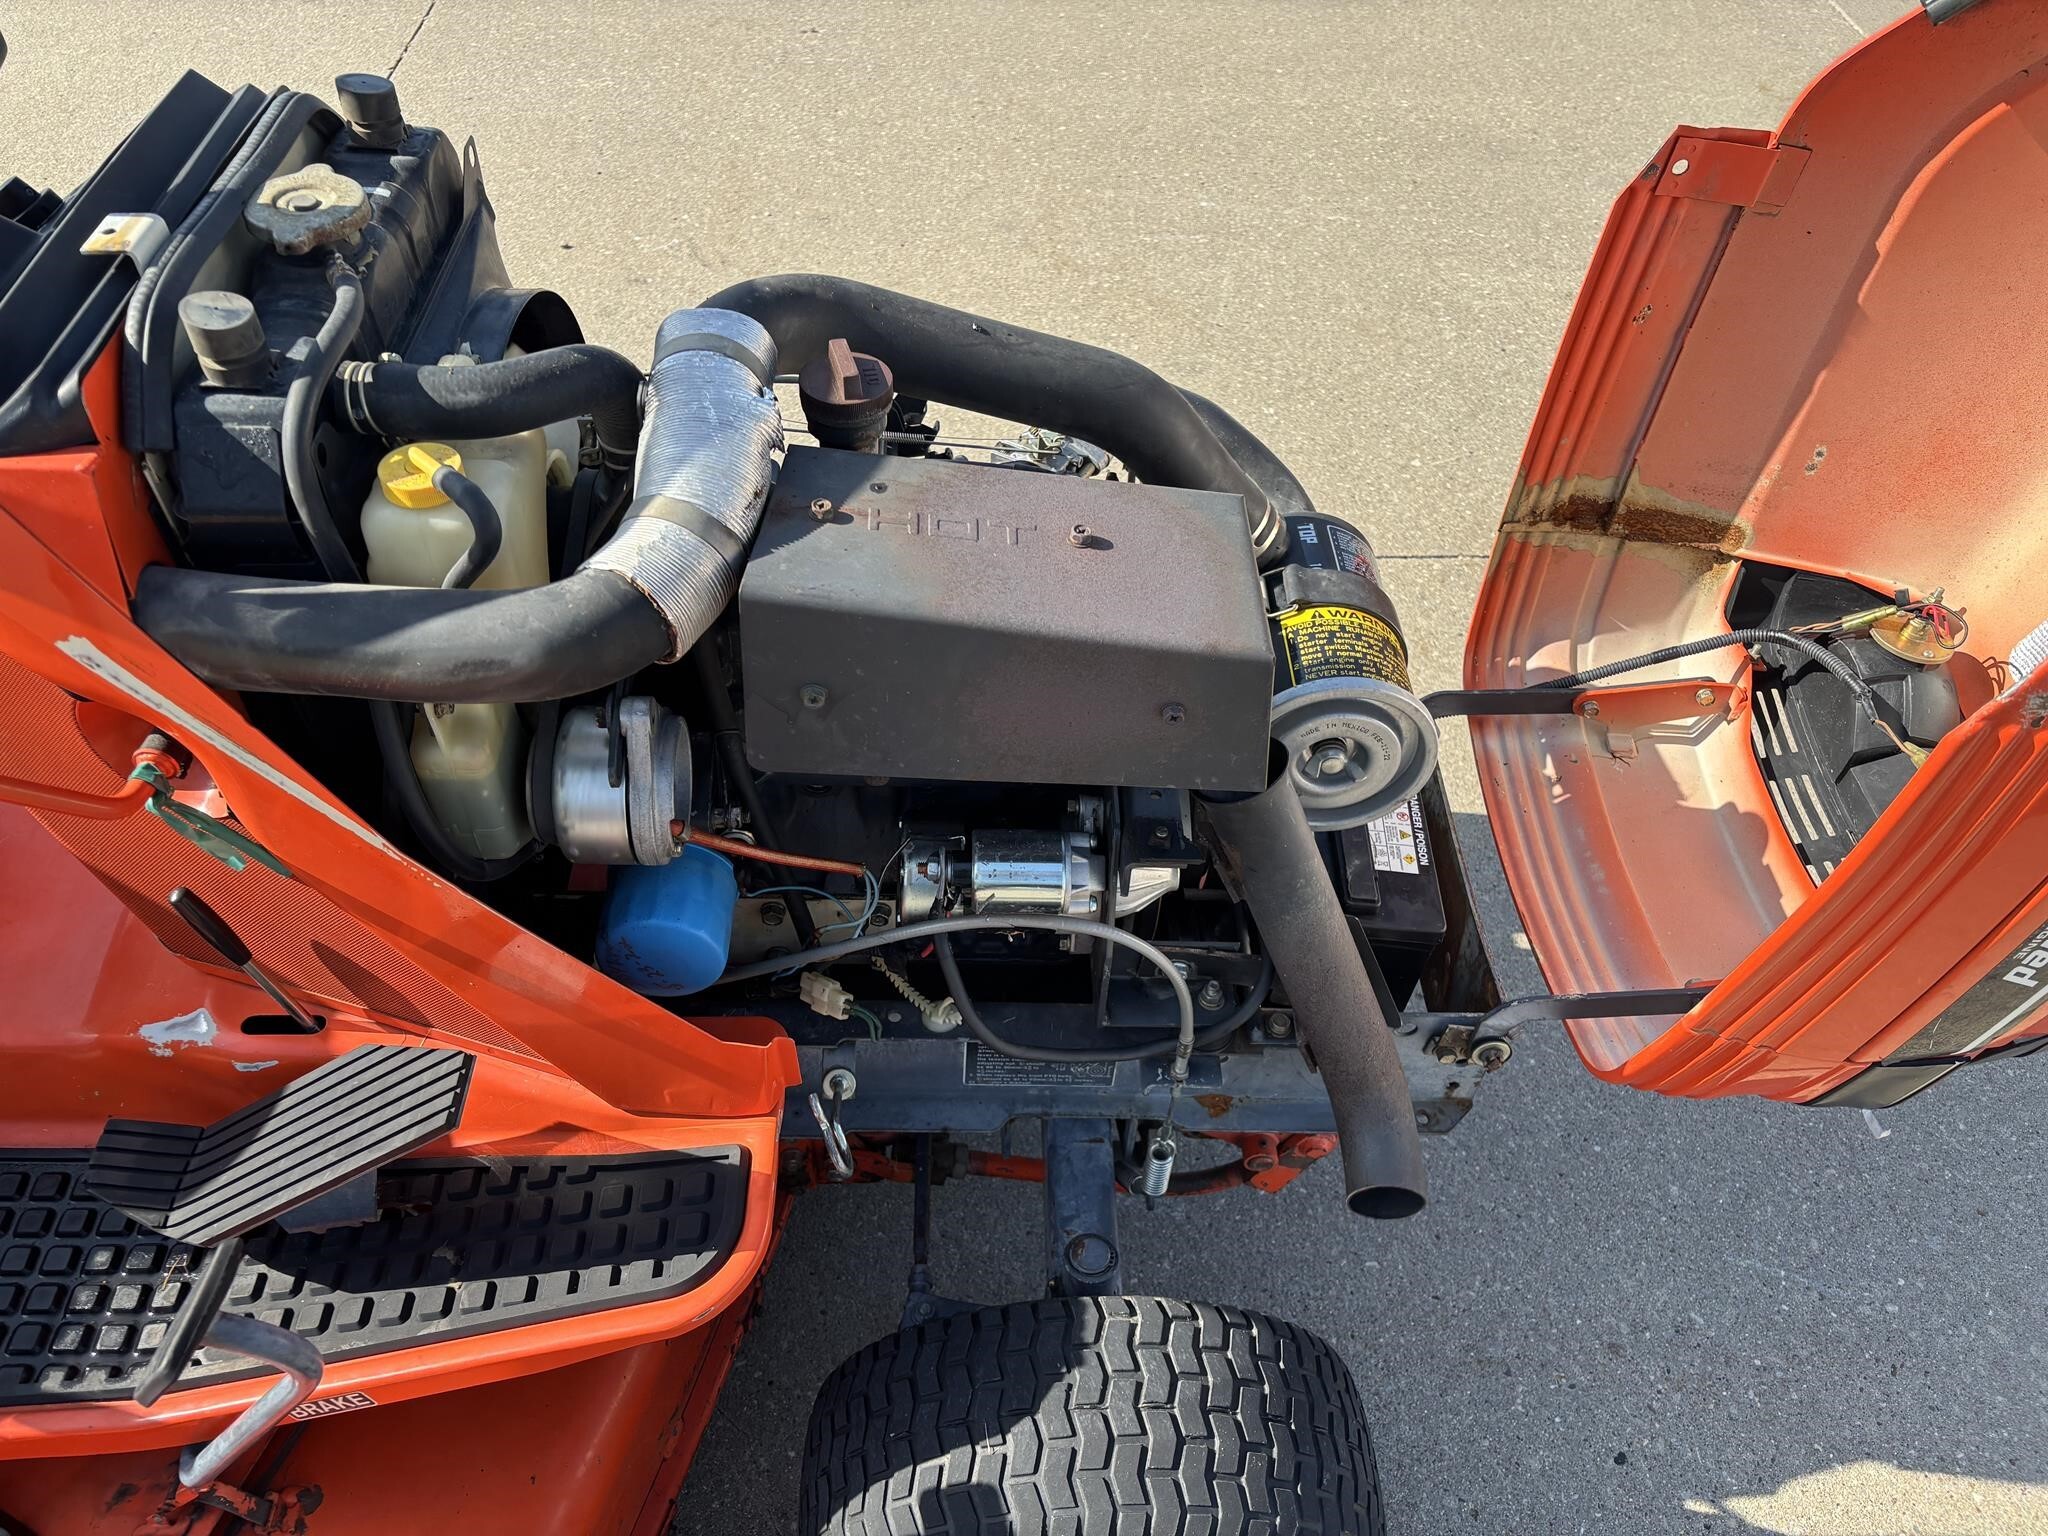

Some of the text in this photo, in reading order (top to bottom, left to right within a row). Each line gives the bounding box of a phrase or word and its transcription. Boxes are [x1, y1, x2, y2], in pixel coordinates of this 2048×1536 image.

[867, 507, 1037, 546] HOT
[1297, 523, 1319, 544] TOP
[1286, 621, 1313, 634] AVOID
[1314, 619, 1361, 628] POSSIBLE
[1299, 626, 1341, 636] MACHINE
[1299, 639, 1328, 649] starter
[1333, 638, 1369, 648] terminals
[1300, 645, 1321, 655] start
[1301, 653, 1323, 662] move
[1302, 658, 1325, 667] Start
[1329, 657, 1355, 665] engine
[1304, 663, 1356, 673] transmission
[1305, 669, 1338, 680] NEVER
[1301, 726, 1321, 739] MADE
[1342, 721, 1370, 734] MEXICO
[290, 1393, 371, 1418] BRAKE
